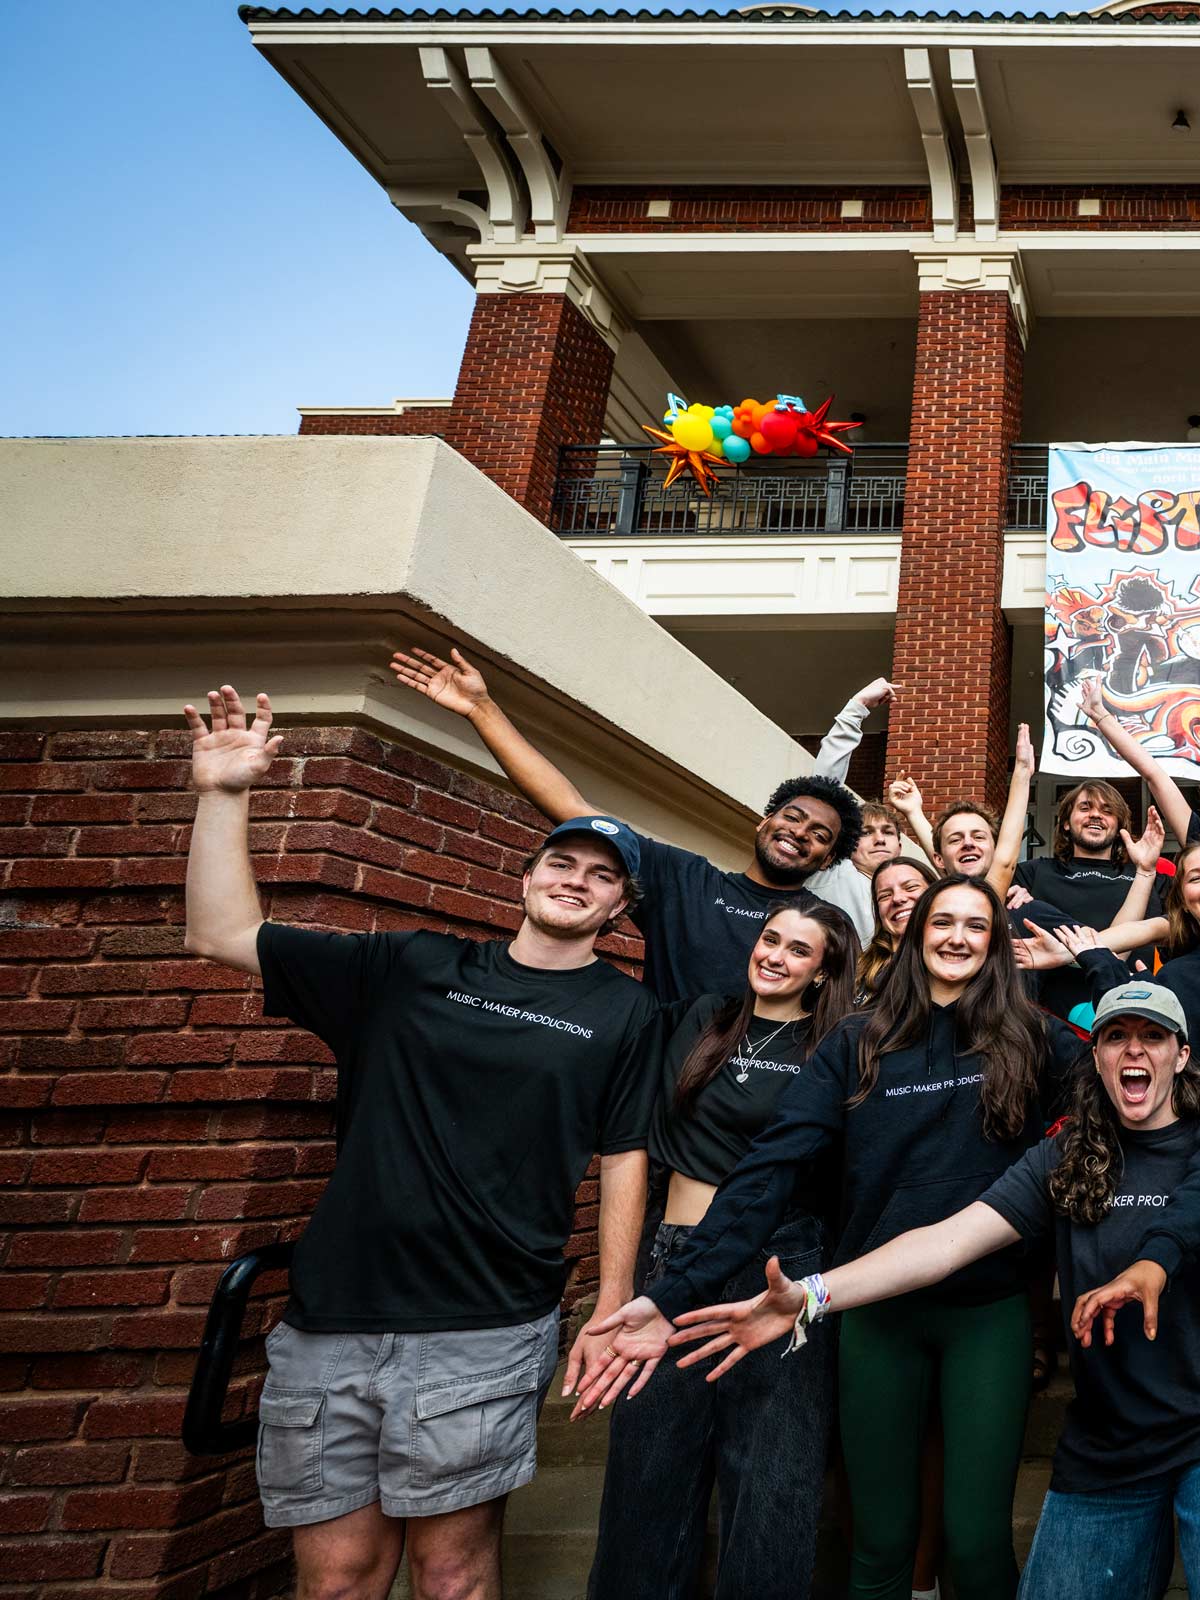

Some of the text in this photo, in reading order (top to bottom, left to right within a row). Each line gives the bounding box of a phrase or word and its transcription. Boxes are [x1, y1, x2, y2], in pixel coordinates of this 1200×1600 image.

[734, 908, 764, 920] MAKER
[446, 990, 593, 1039] MUSIC MAKER PRODUCTIONS
[749, 1060, 801, 1075] PRODUCTIO
[885, 1085, 911, 1097] MUSIC
[912, 1082, 942, 1093] MAKER
